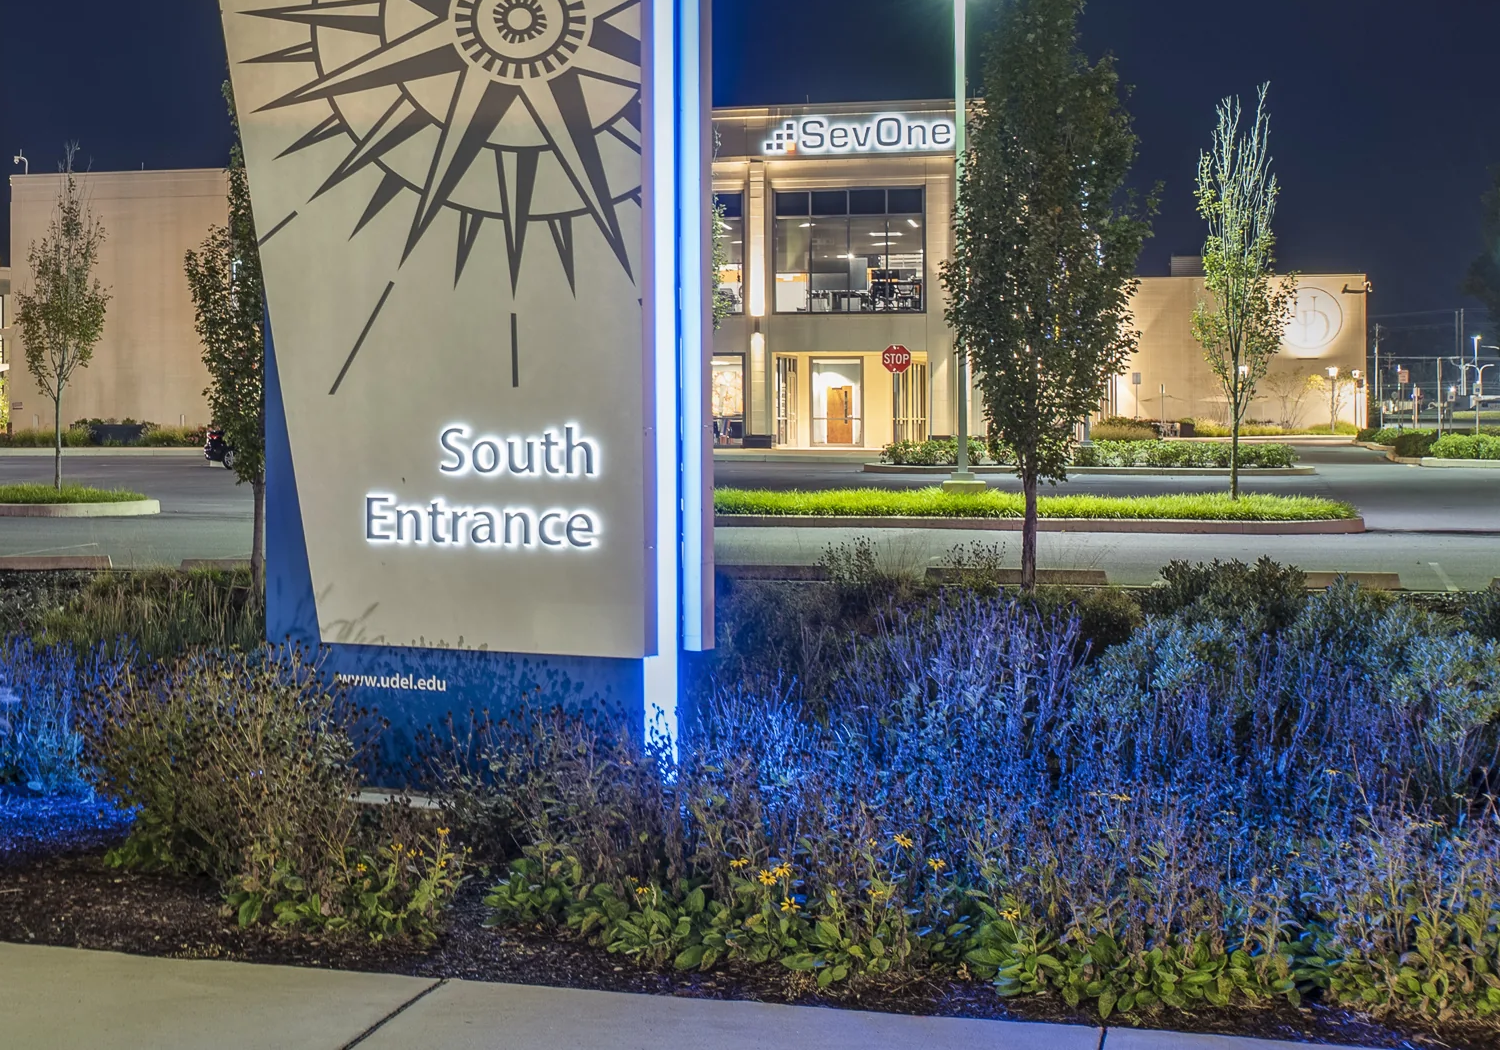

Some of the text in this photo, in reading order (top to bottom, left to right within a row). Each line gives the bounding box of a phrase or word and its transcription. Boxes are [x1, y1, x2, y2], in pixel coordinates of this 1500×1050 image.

[801, 117, 951, 149] SevOne
[883, 353, 910, 365] STOP
[439, 425, 596, 474] South
[365, 496, 597, 548] Entrance
[339, 673, 447, 692] www.udel.edu
